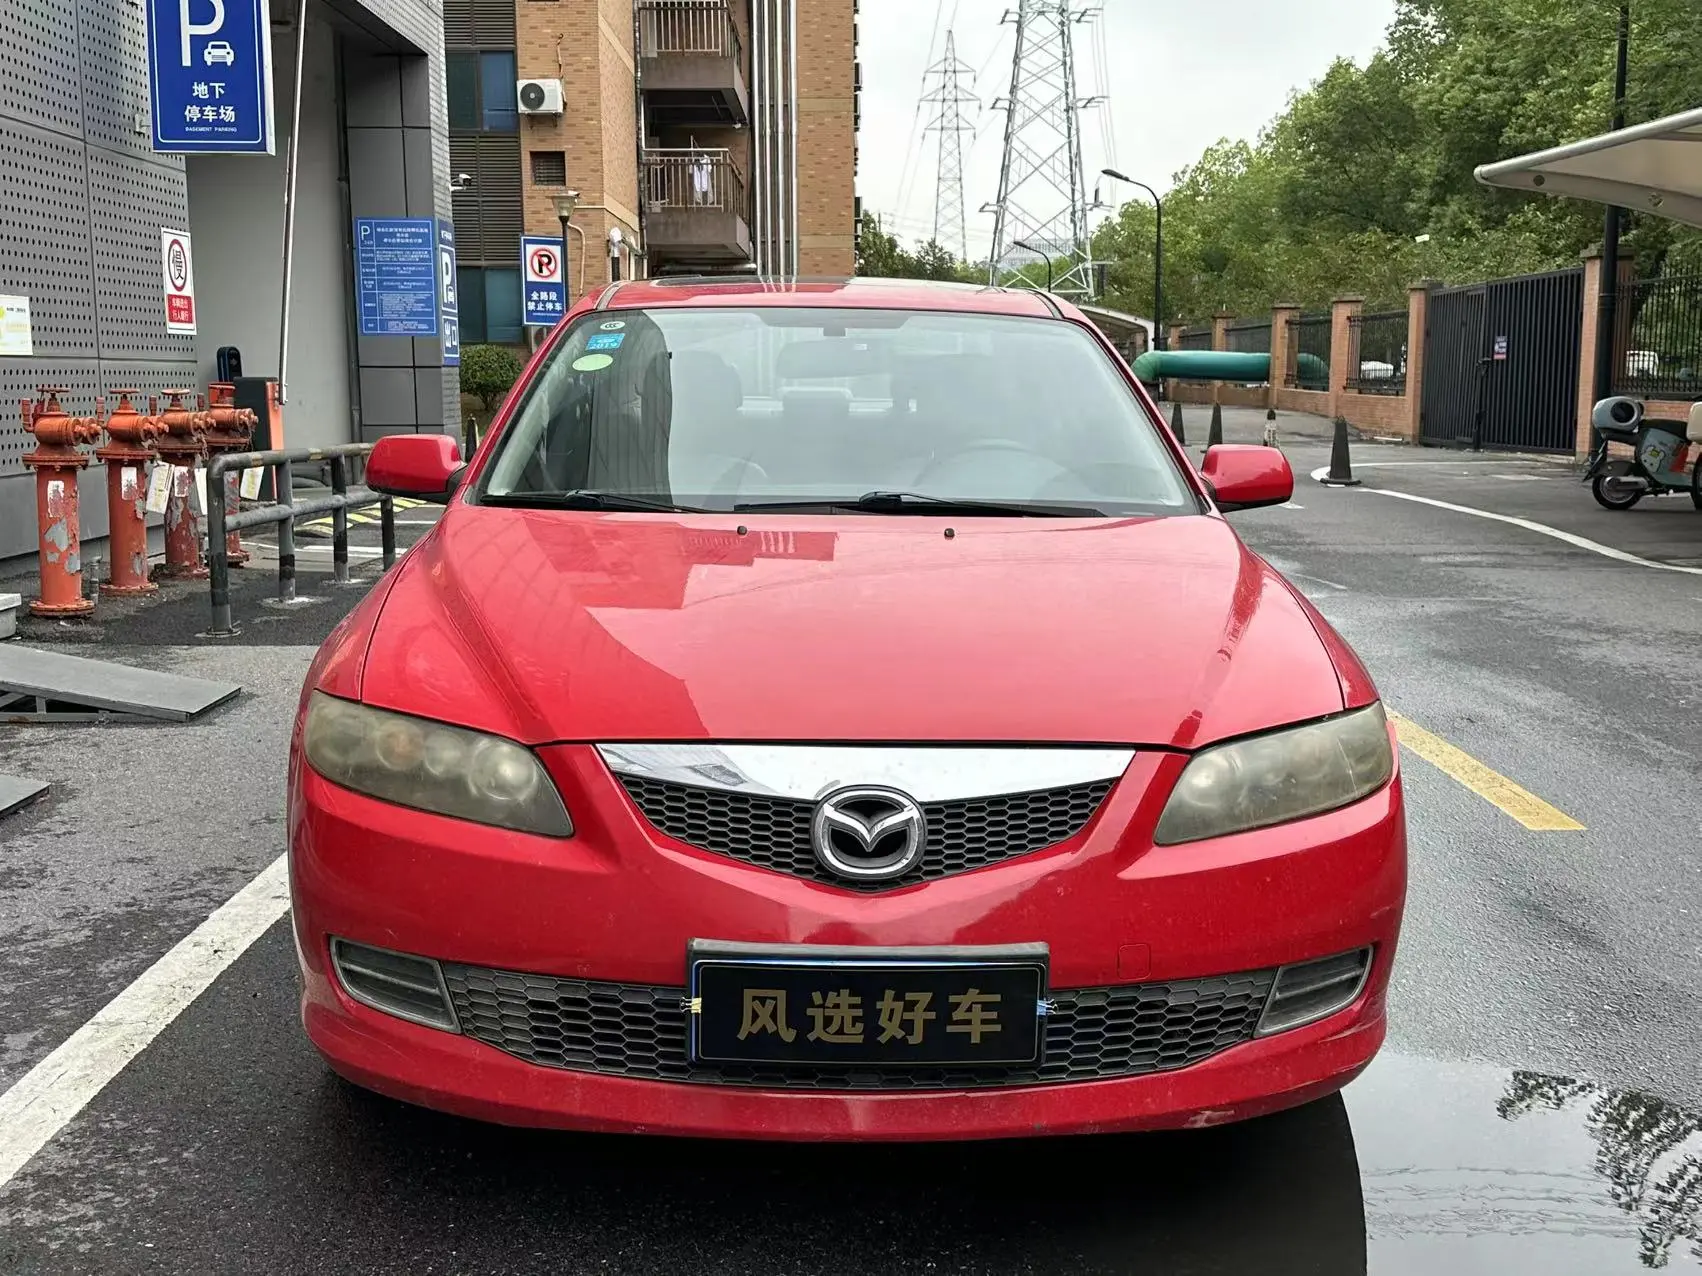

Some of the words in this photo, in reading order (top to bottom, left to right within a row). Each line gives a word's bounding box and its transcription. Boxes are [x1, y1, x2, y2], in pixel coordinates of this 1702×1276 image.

[179, 0, 225, 67] P
[192, 81, 226, 99] 地下
[184, 105, 236, 122] 停车场
[361, 225, 371, 241] P
[172, 249, 184, 280] 慢
[531, 290, 558, 301] 全路段
[527, 301, 563, 312] 禁止停车
[737, 988, 1002, 1044] 风选好车
